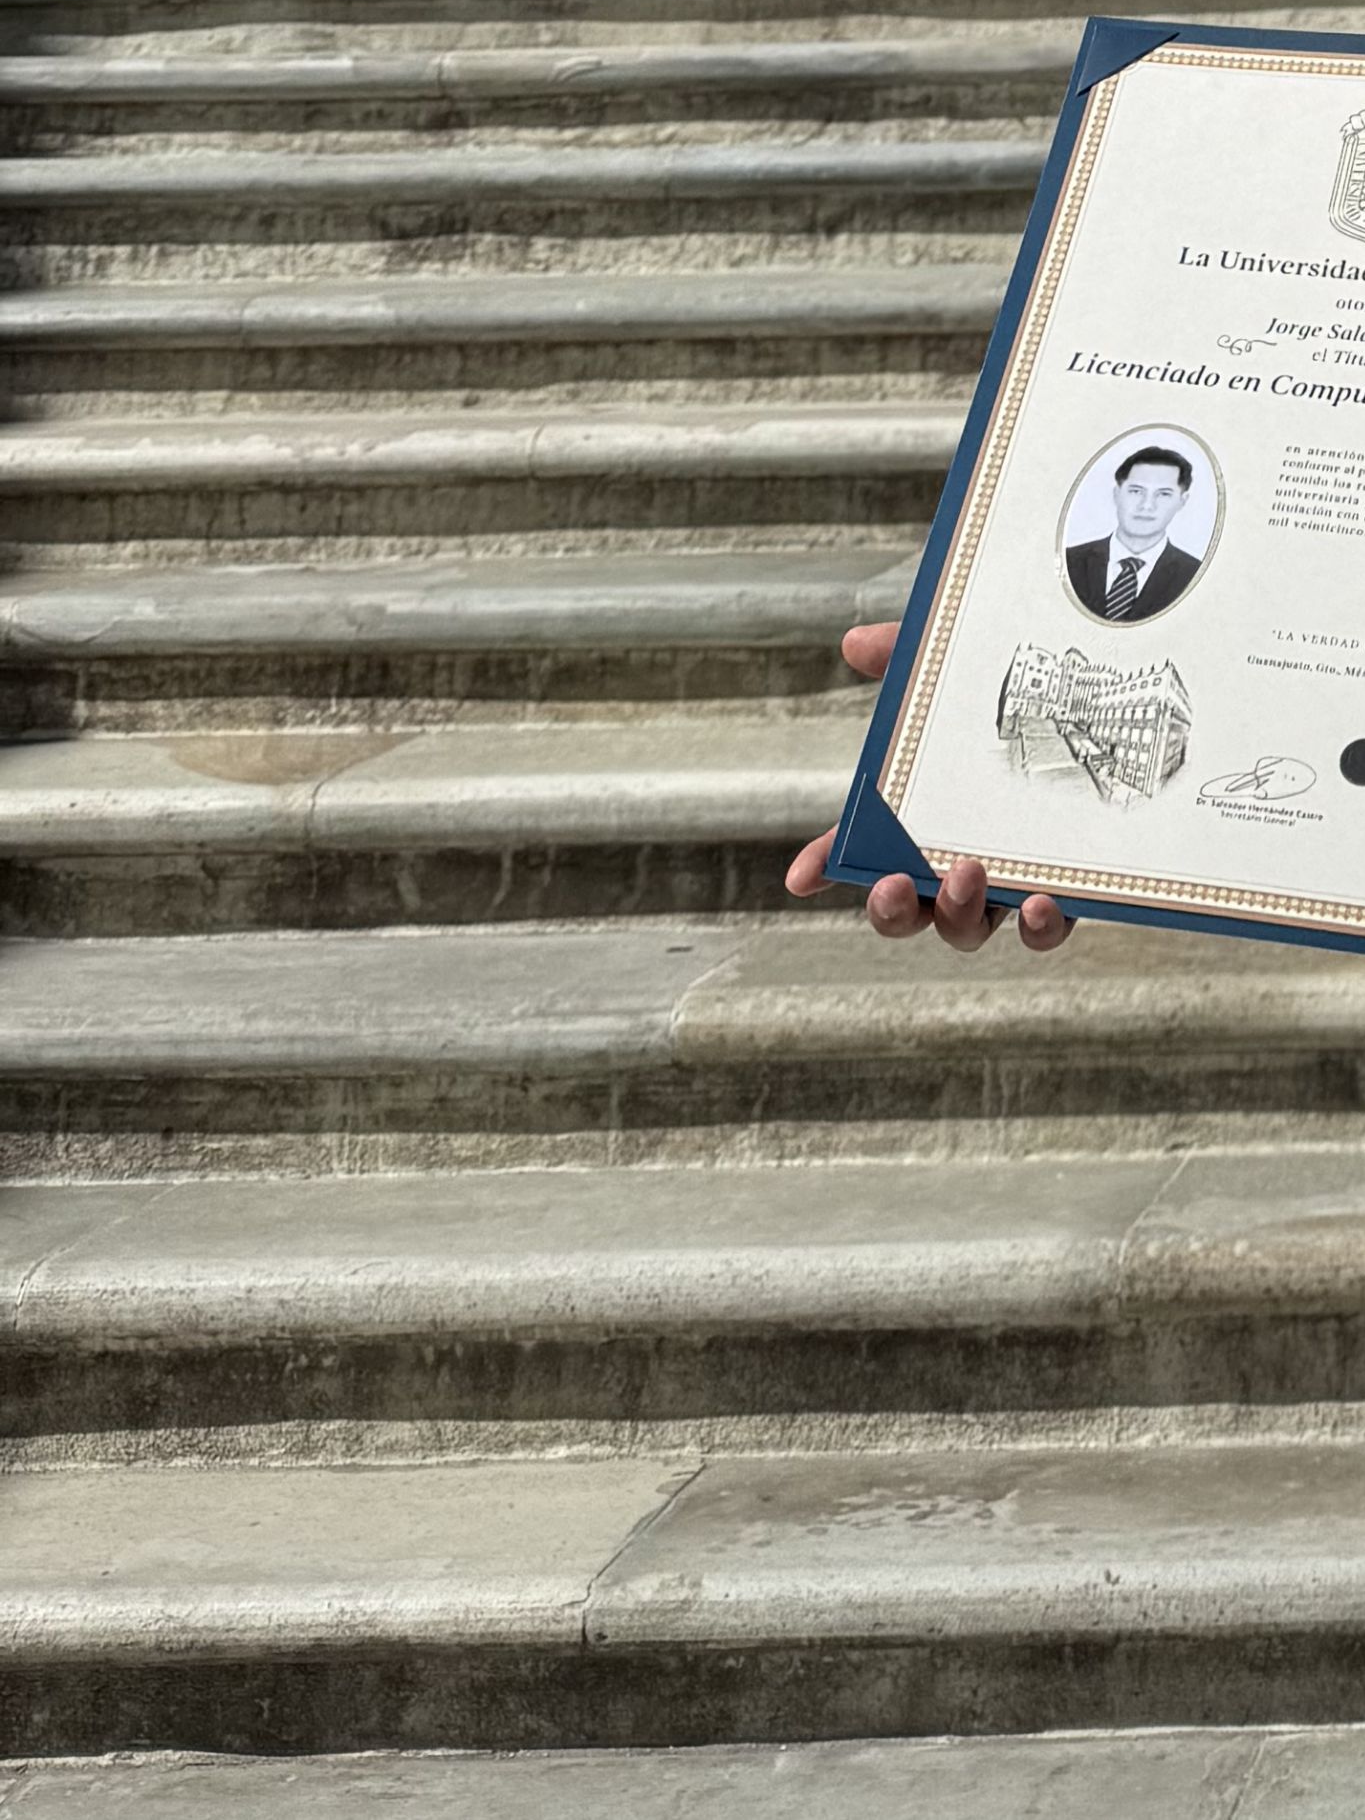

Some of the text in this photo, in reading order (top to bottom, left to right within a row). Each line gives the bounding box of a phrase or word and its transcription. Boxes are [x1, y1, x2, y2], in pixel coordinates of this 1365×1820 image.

[1179, 247, 1209, 267] La
[1266, 318, 1322, 340] Jorge
[1312, 348, 1327, 362] el
[1067, 352, 1220, 387] Licenciado
[1229, 376, 1260, 391] en
